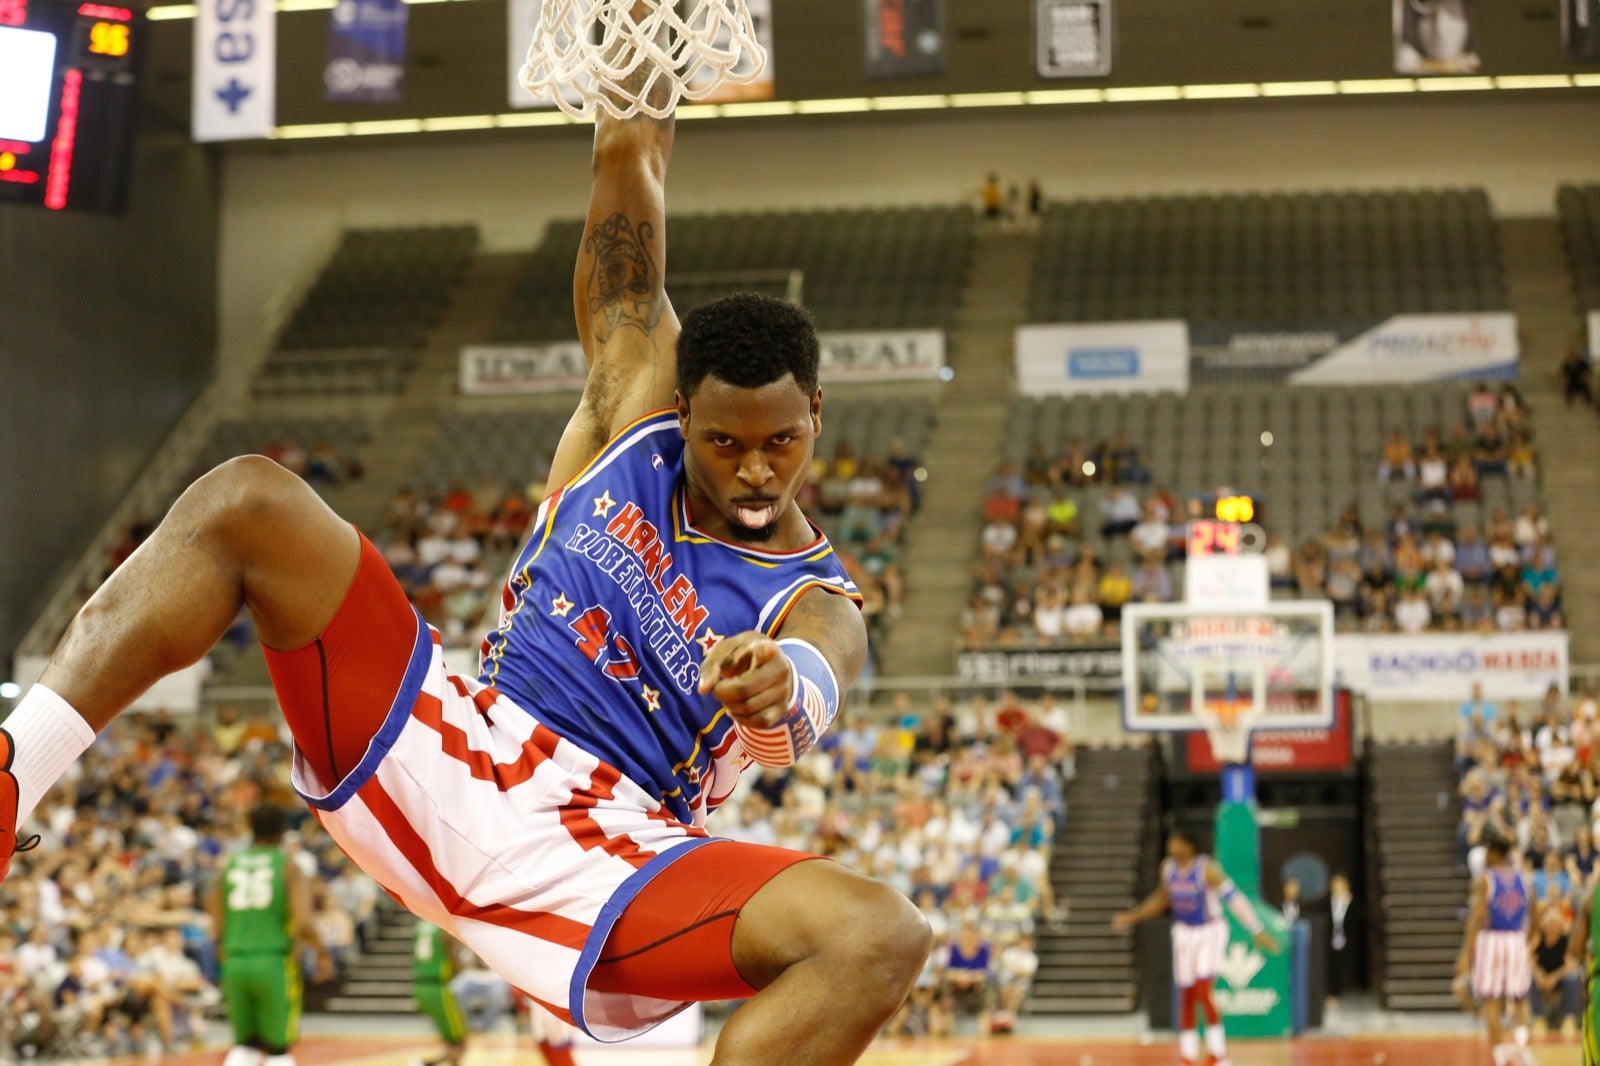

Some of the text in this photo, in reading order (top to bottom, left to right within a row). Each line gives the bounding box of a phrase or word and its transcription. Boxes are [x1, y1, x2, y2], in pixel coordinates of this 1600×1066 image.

[605, 501, 710, 644] HARLEM
[1189, 521, 1240, 557] 24
[565, 523, 700, 693] GLOBETROTTERS
[568, 603, 642, 683] 47
